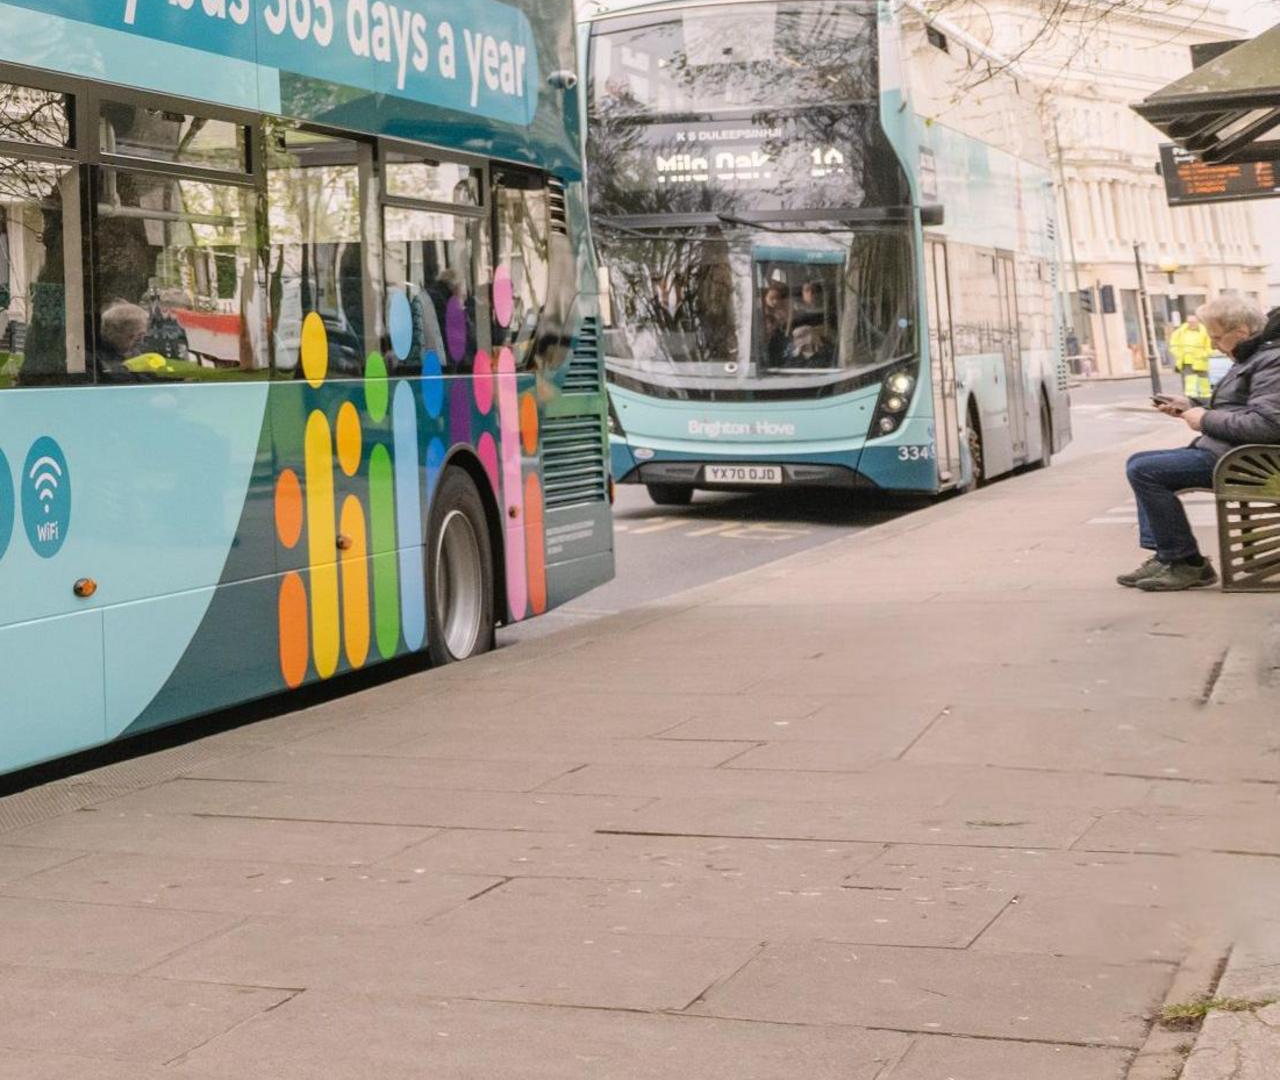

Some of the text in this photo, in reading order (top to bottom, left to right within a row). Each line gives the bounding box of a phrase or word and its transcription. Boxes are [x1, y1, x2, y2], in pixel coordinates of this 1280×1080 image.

[437, 19, 456, 80] a
[462, 28, 526, 108] year
[712, 468, 775, 480] YX70 OJD
[36, 521, 60, 543] WiFi
